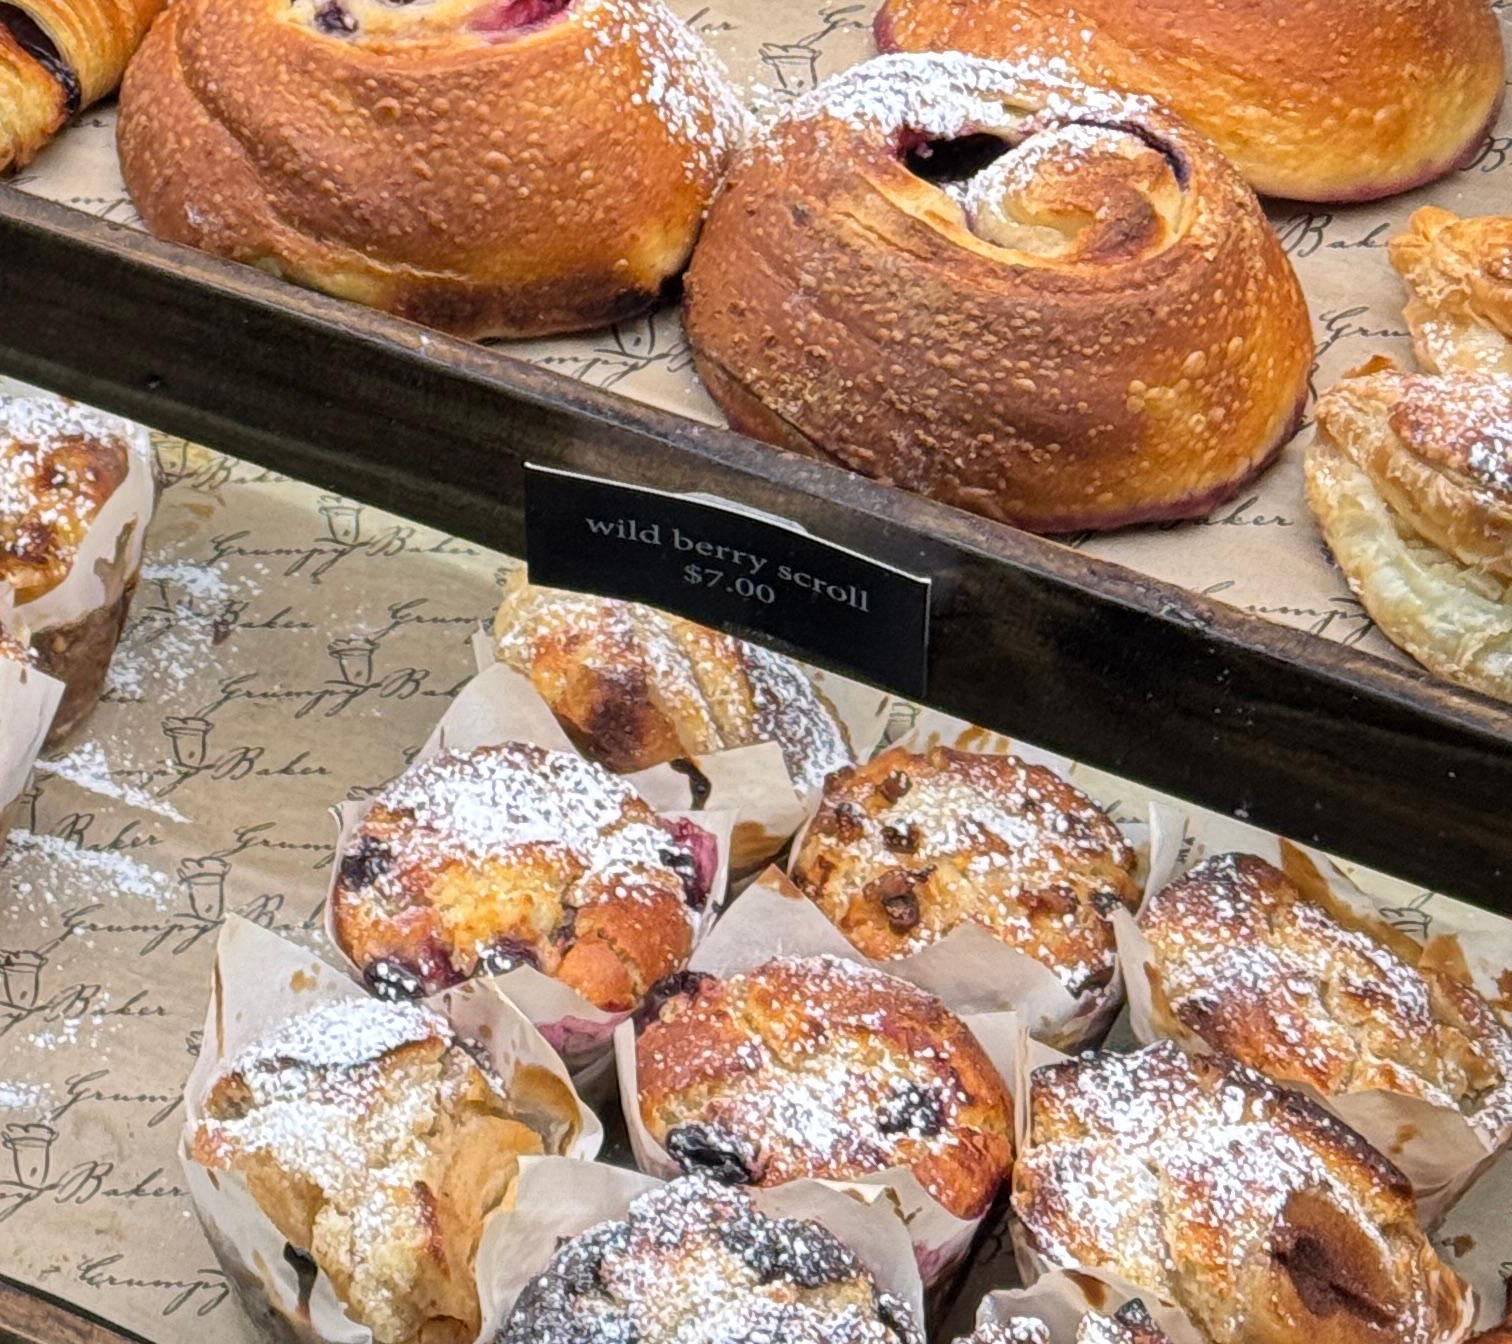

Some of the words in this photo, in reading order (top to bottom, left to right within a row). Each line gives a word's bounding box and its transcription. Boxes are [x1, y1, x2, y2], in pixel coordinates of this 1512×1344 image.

[585, 517, 661, 545] wild
[672, 528, 767, 574] berry
[777, 564, 869, 613] scroll
[683, 564, 775, 604] $7.00
[211, 746, 333, 781] Baker
